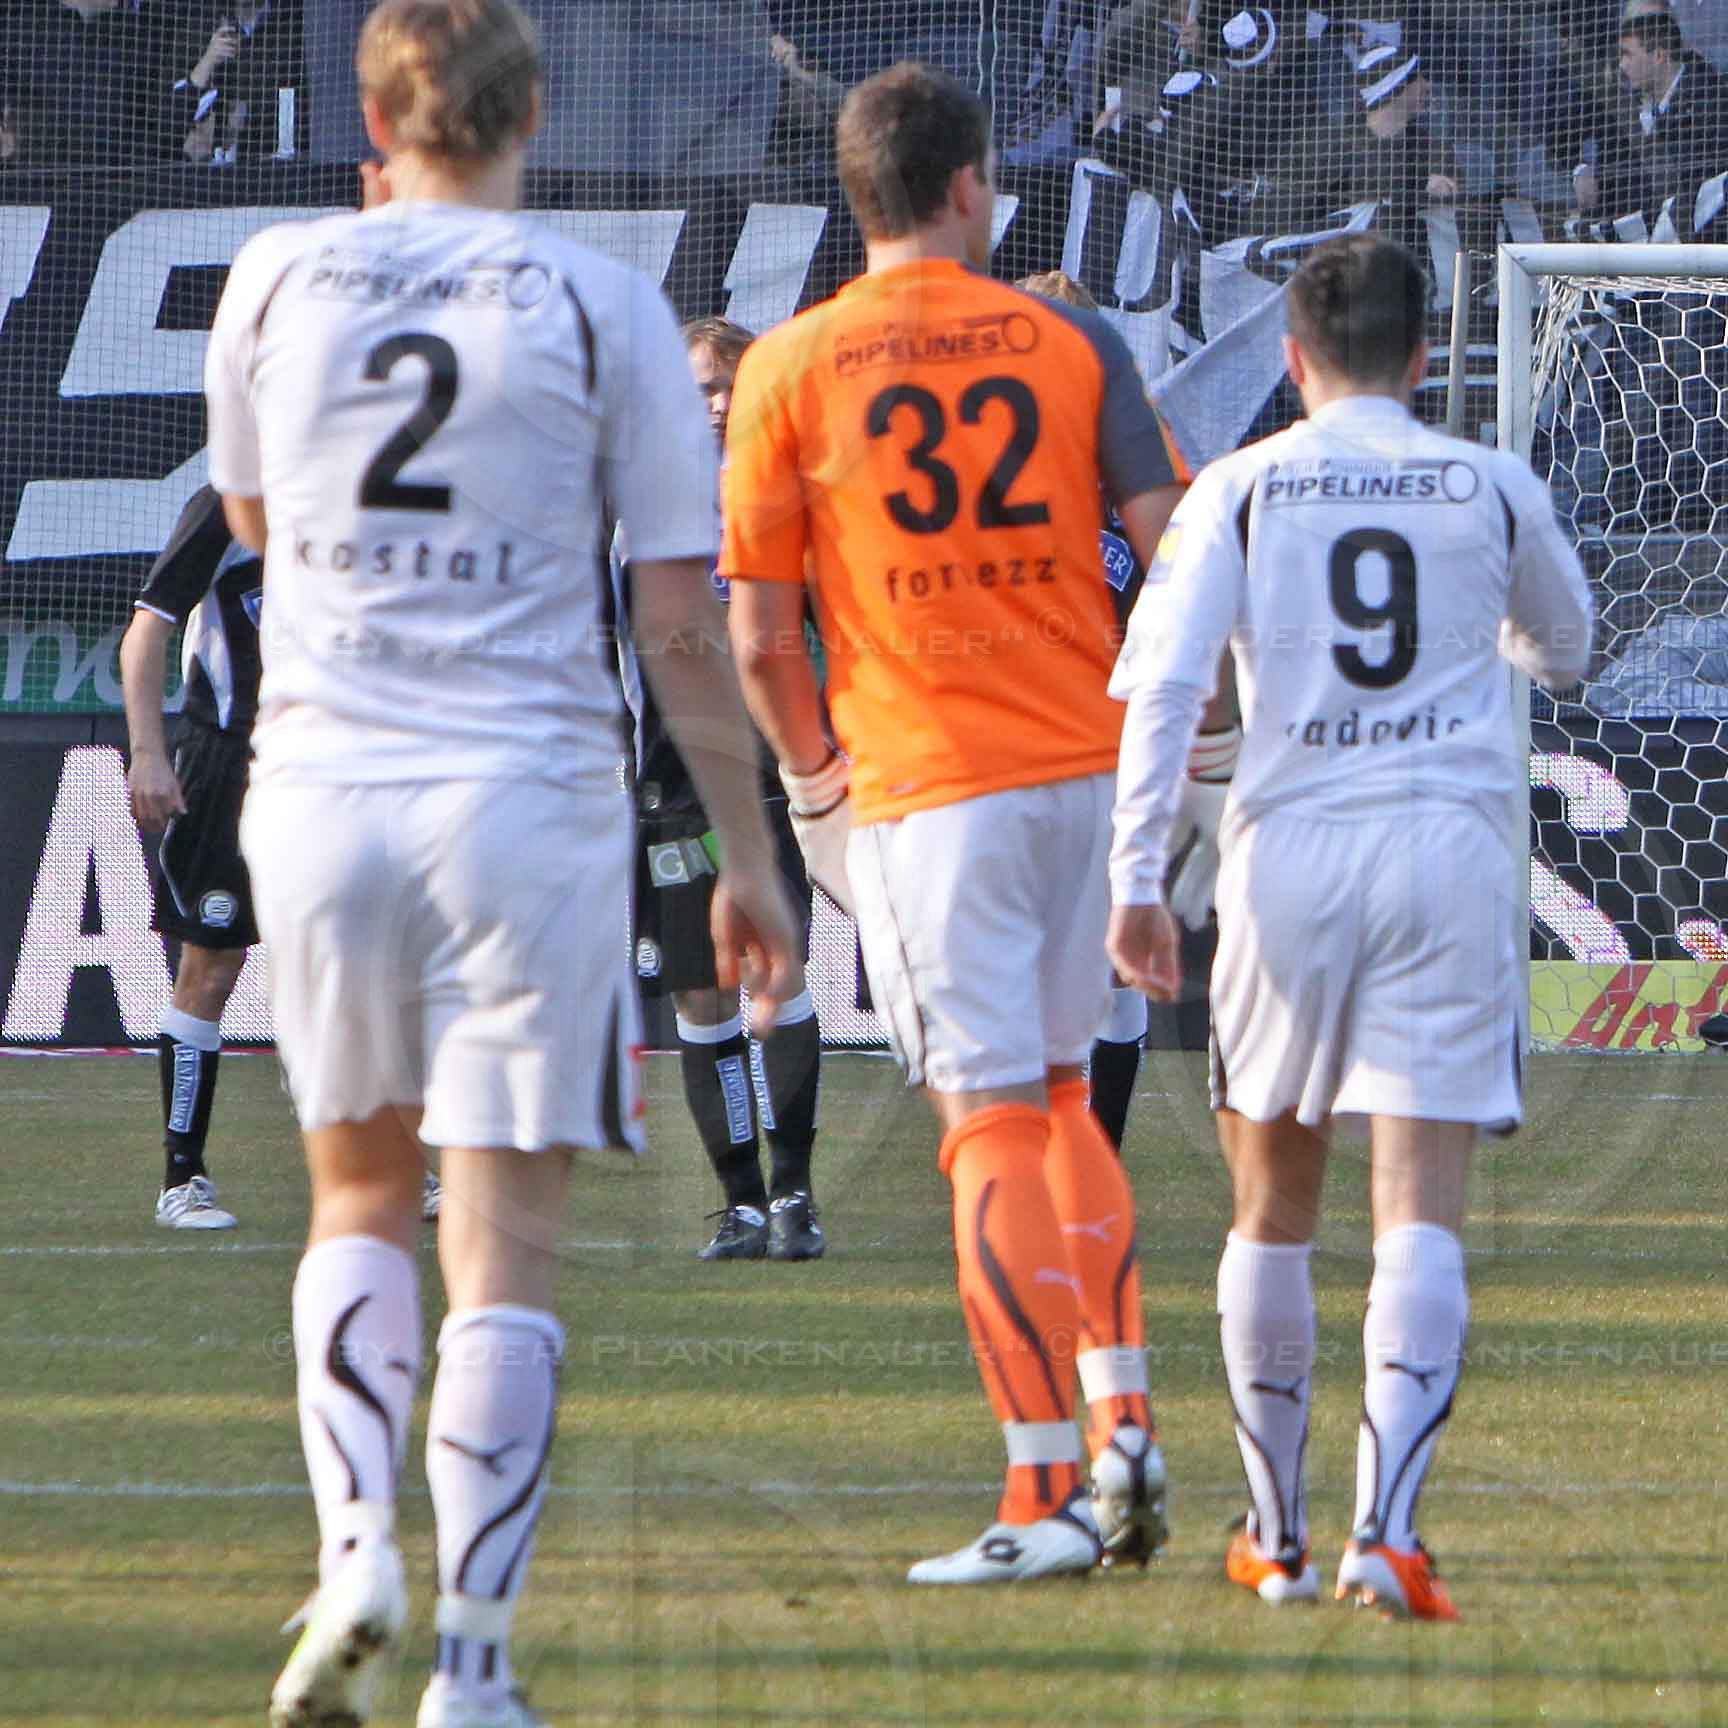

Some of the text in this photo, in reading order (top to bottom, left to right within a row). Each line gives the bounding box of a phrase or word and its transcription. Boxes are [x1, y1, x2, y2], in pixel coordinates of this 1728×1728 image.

[357, 330, 459, 513] 2
[866, 376, 1051, 537] 32
[1263, 473, 1441, 503] PIPELINES
[1326, 527, 1420, 688] 9
